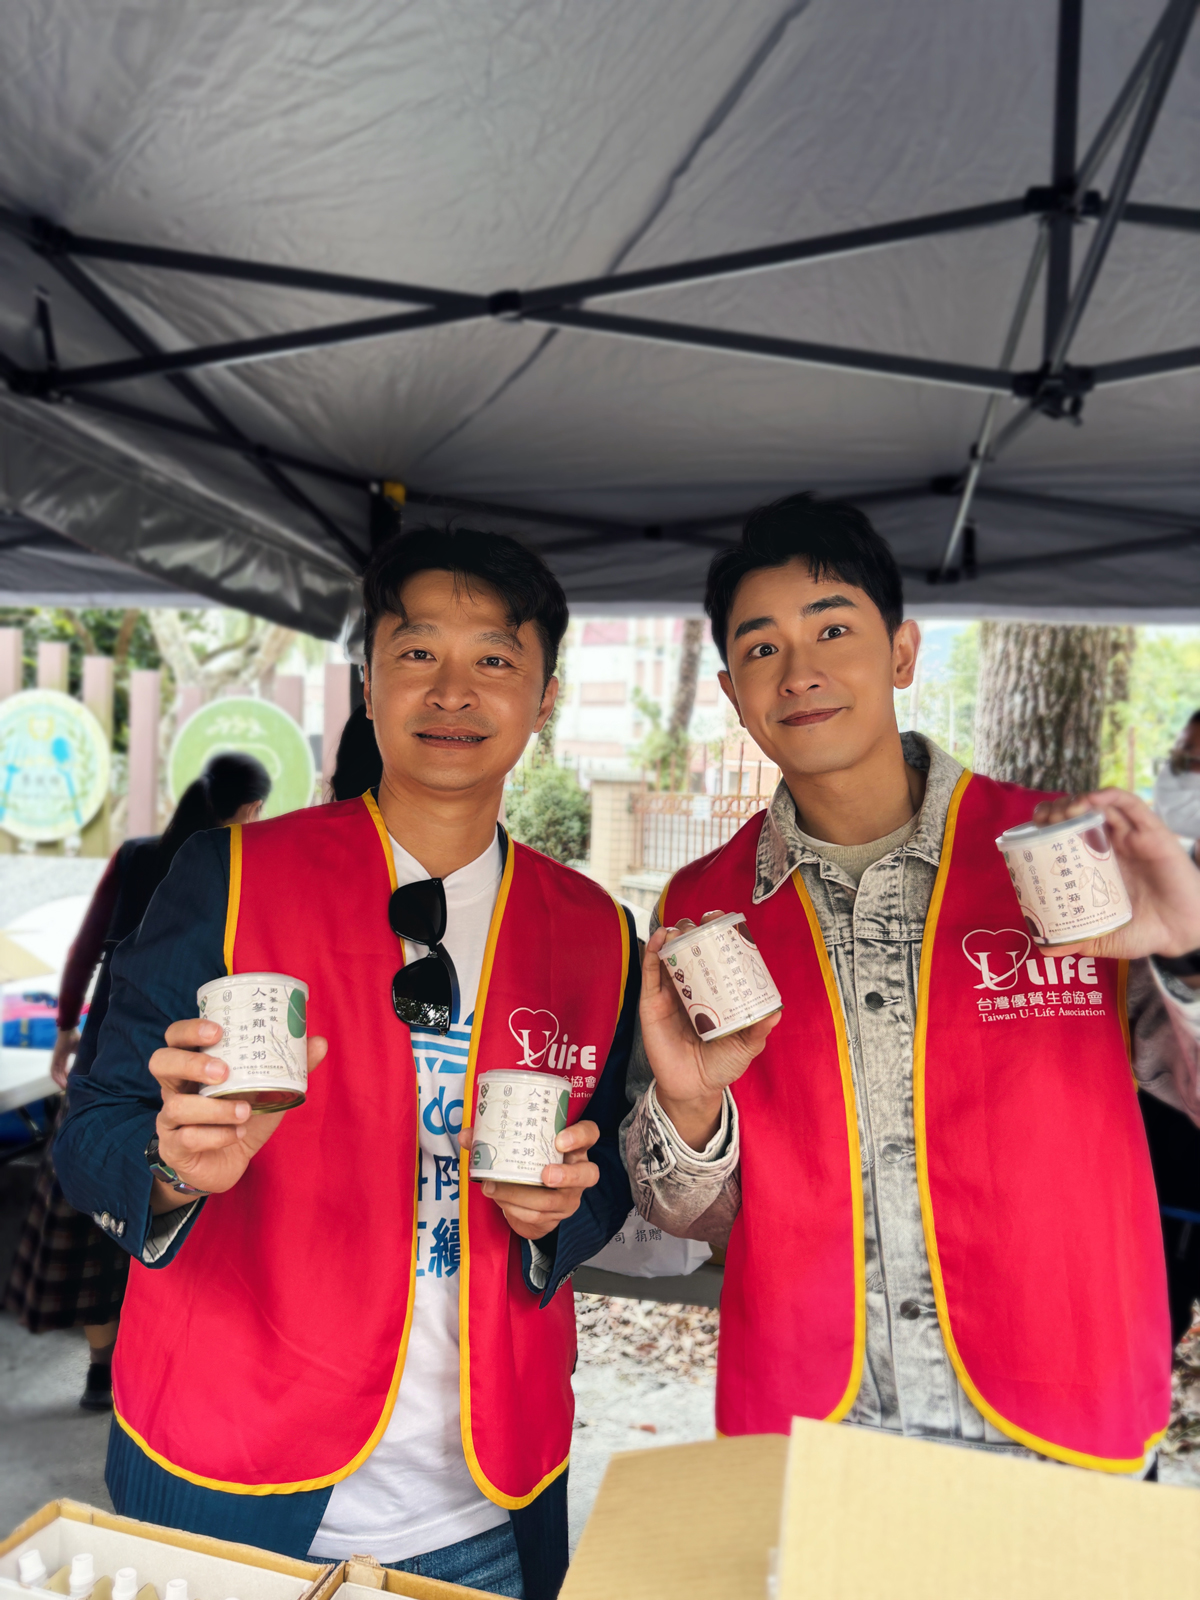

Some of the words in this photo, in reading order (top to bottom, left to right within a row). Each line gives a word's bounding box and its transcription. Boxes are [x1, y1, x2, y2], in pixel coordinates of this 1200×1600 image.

[976, 990, 1103, 1012] 台灣優質生命協會
[979, 1012, 1017, 1022] Taiwan
[1019, 1008, 1056, 1018] U-Life
[1058, 1007, 1106, 1017] Association
[569, 1090, 594, 1098] ciatio
[418, 1086, 464, 1135] do
[635, 1228, 662, 1242] 捐贈
[416, 1217, 460, 1278] 續
